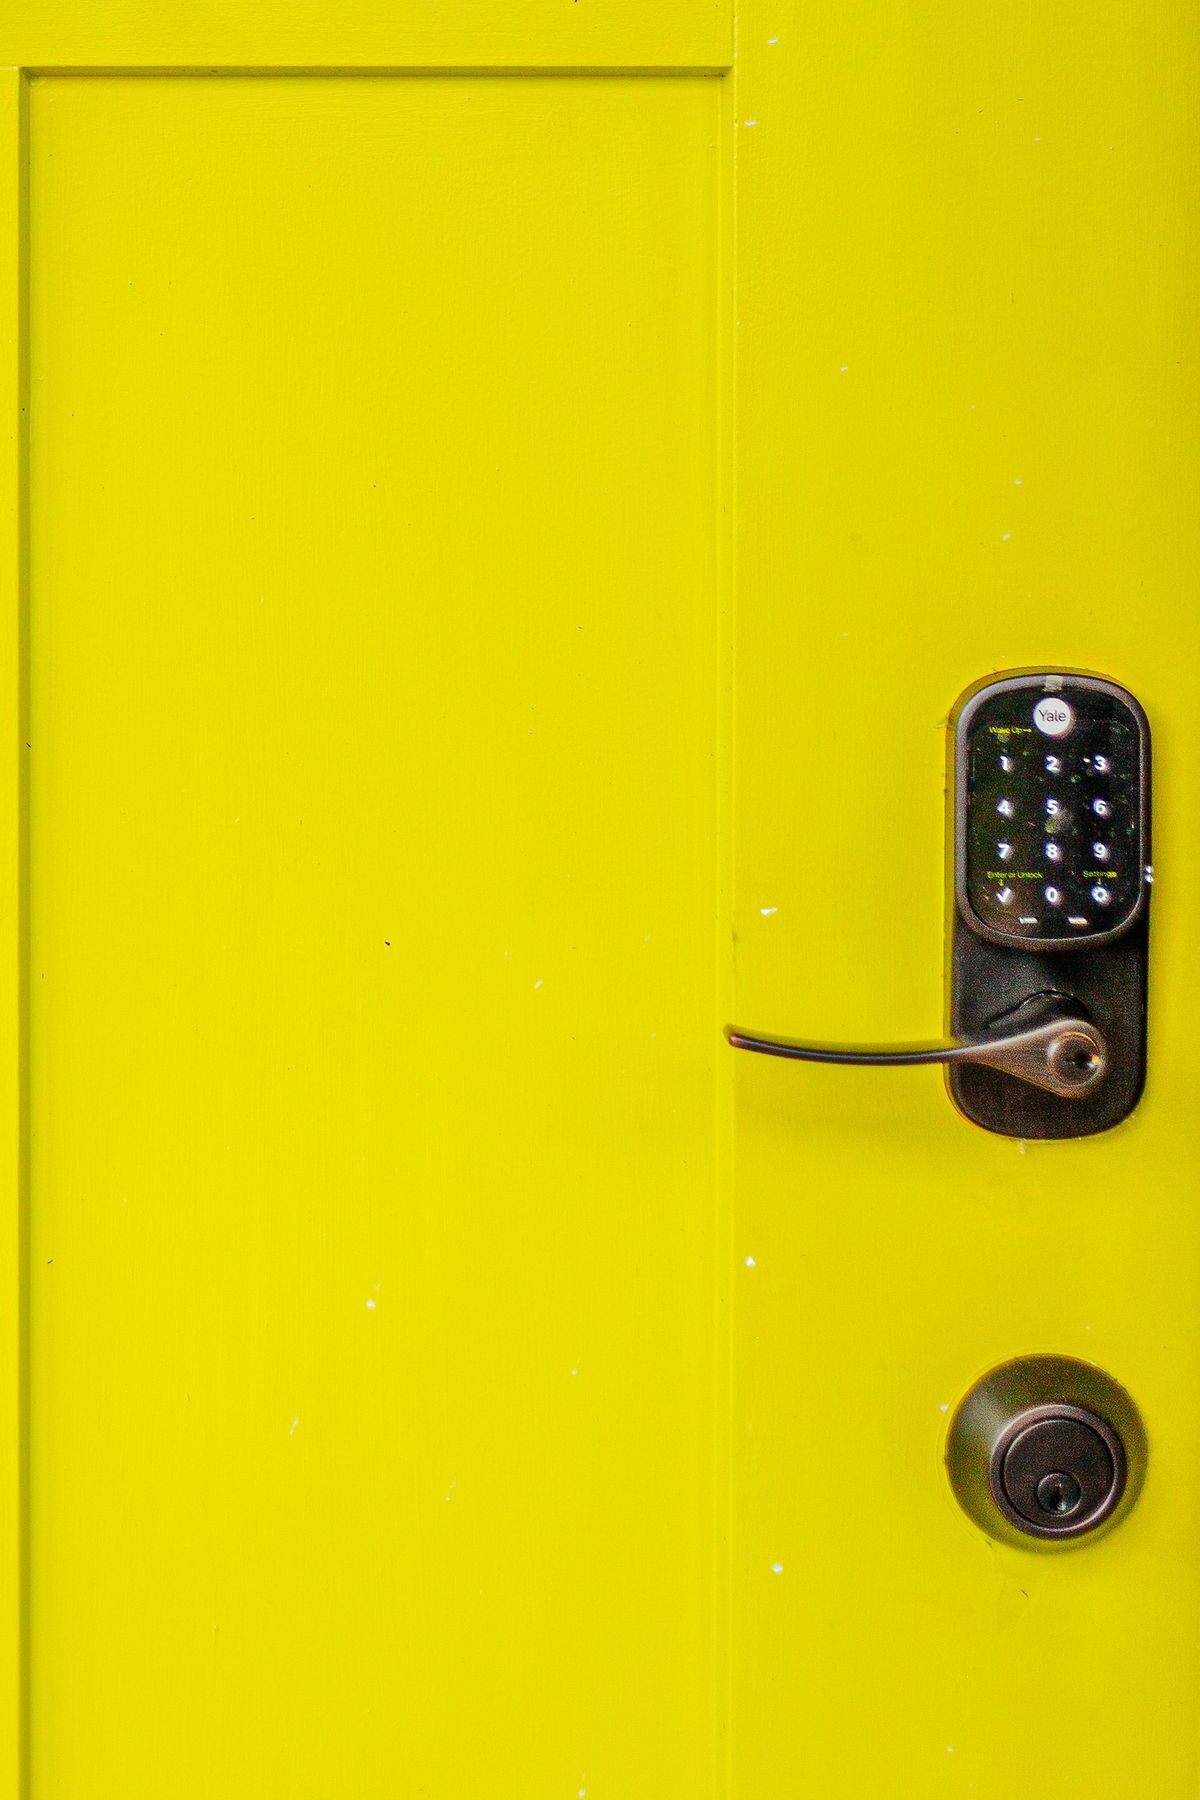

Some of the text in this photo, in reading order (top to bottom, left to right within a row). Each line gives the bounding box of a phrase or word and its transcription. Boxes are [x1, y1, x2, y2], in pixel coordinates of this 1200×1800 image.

[1038, 709, 1066, 722] Yale
[999, 754, 1107, 772] 1 2 3
[997, 798, 1106, 817] 4 5 6
[998, 842, 1106, 859] 7 8 9
[987, 871, 1007, 879] Enter
[1045, 887, 1058, 903] 0
